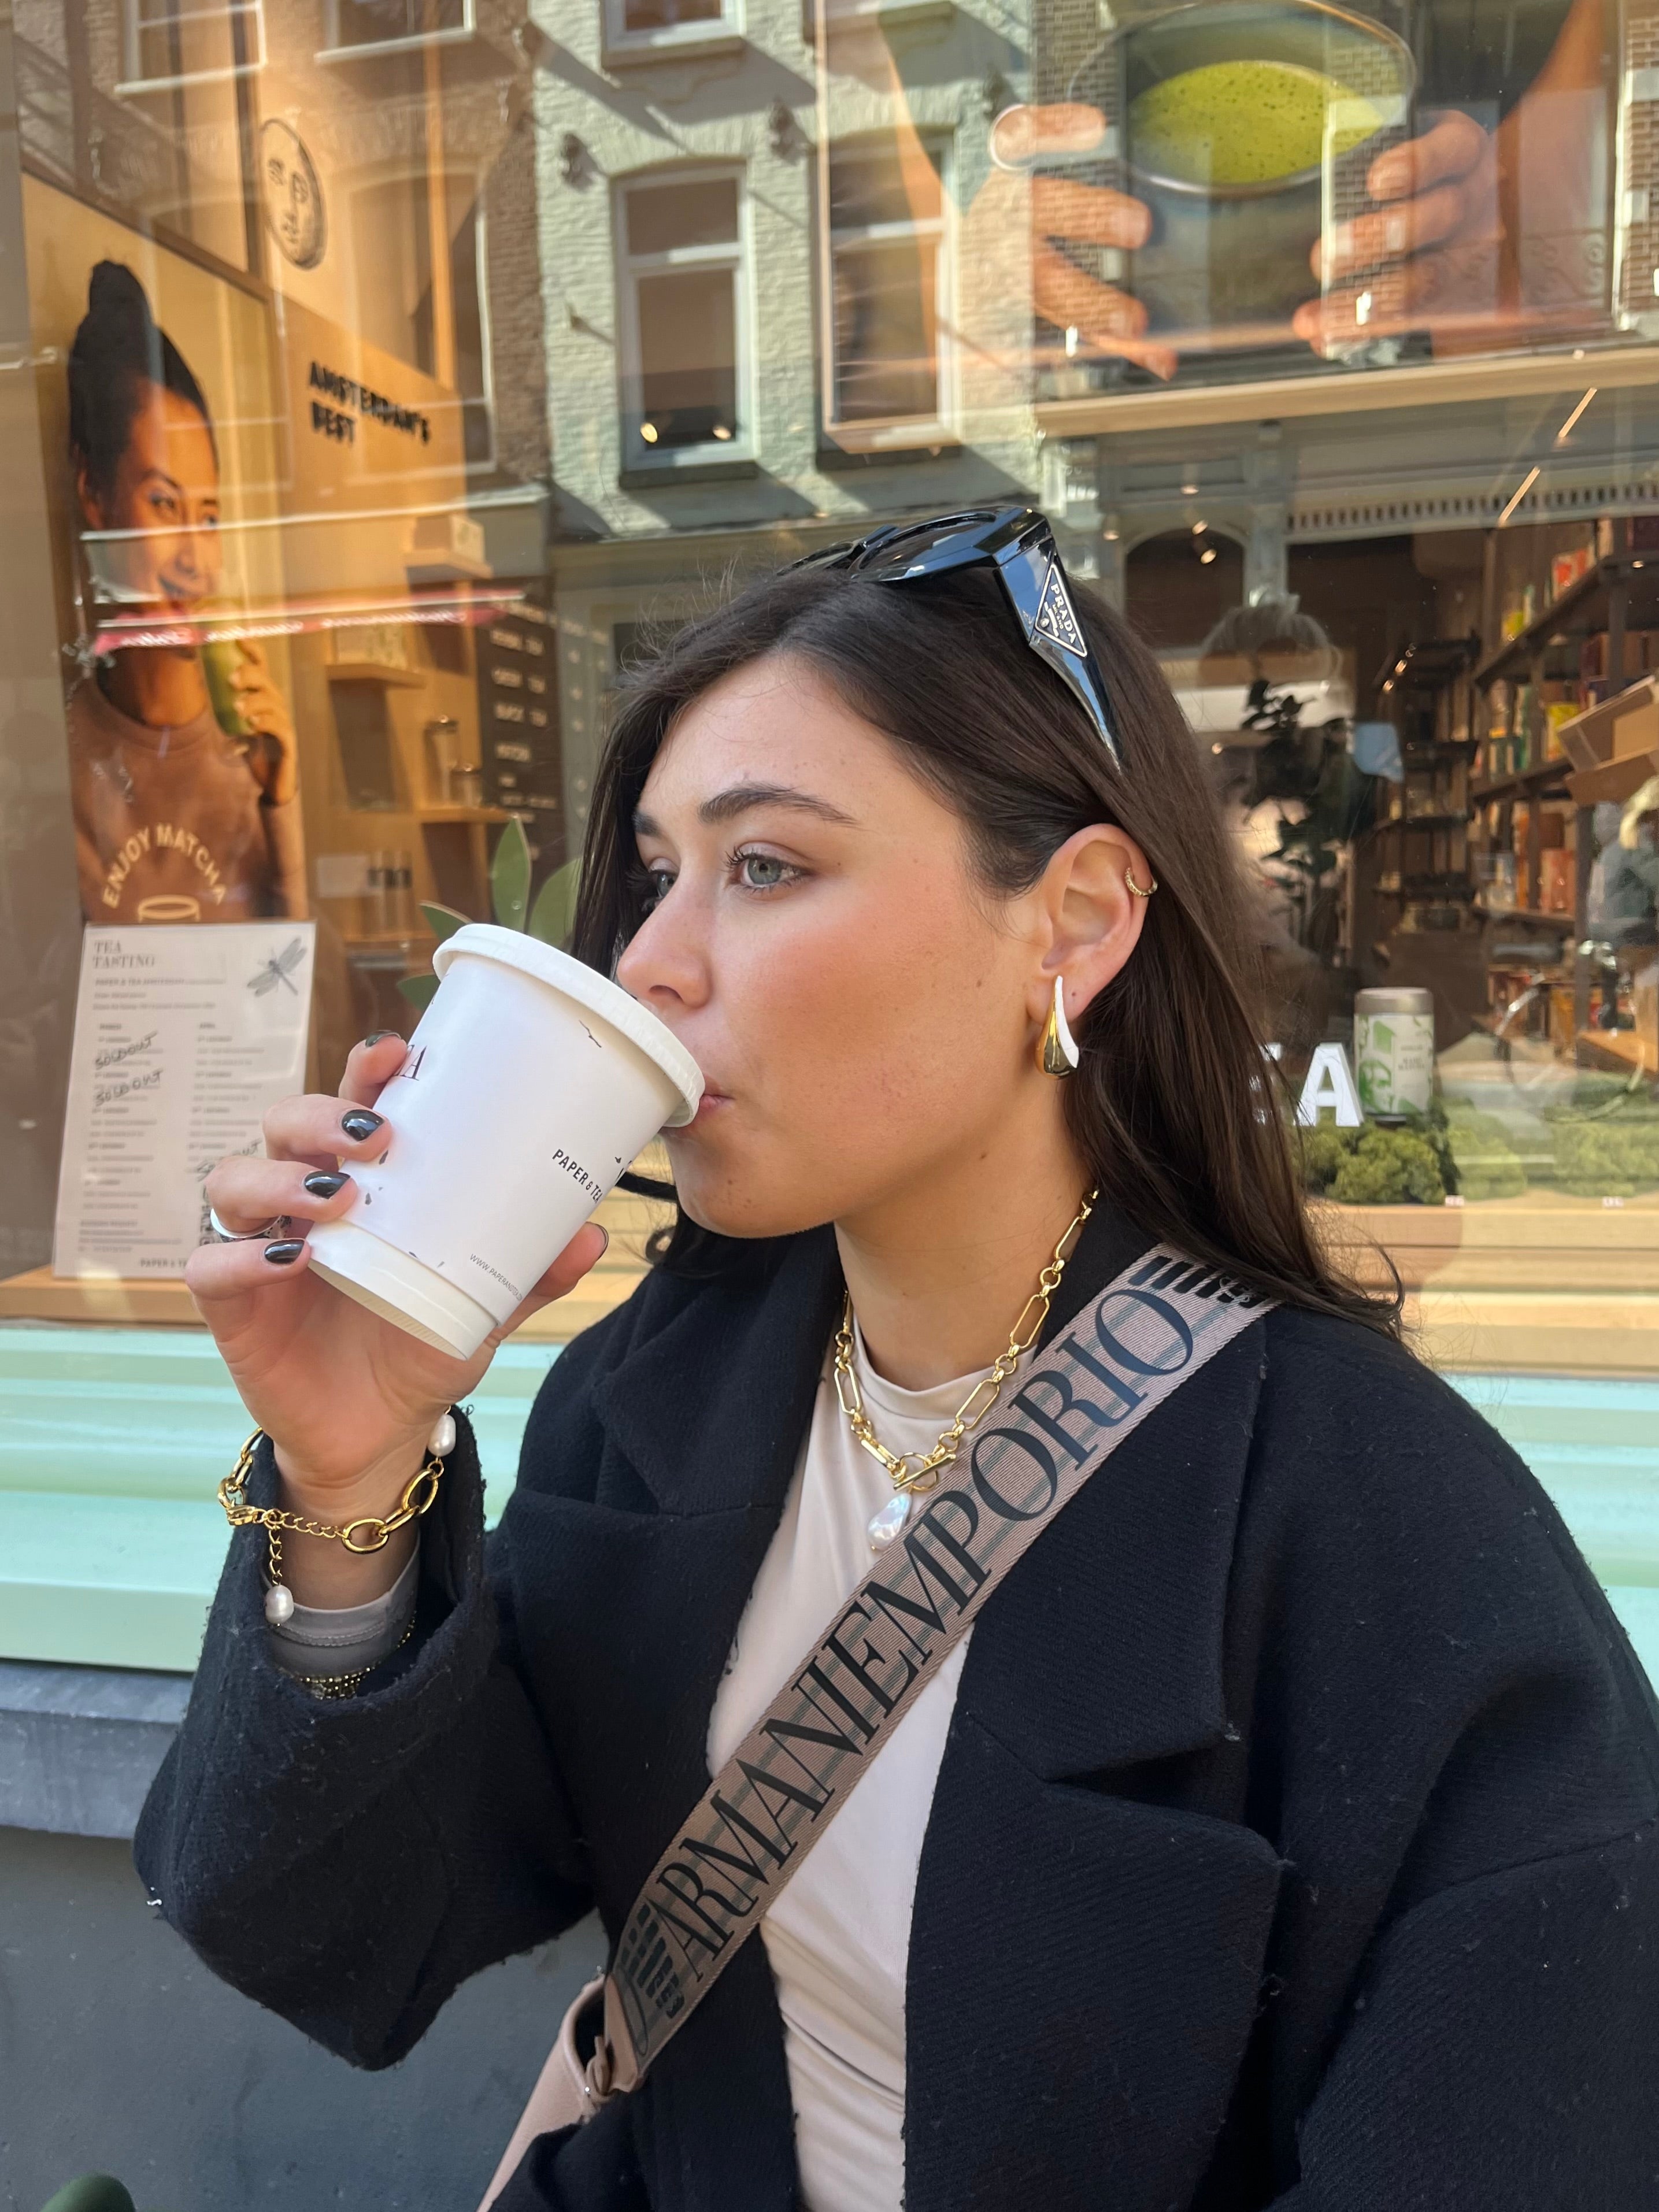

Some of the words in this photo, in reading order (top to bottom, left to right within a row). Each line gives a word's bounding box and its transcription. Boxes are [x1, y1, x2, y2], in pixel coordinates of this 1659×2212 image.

[309, 360, 431, 445] AMSTERDAM'S
[312, 401, 354, 445] BEST
[1050, 583, 1077, 644] PRADA
[1052, 603, 1064, 629] MILANO
[102, 825, 150, 909] ENJOY
[156, 822, 227, 906] MATCHA
[93, 955, 155, 969] TASTING
[94, 939, 122, 954] TEA
[95, 1083, 130, 1107] SOLD
[132, 1068, 164, 1090] OUT
[552, 1148, 588, 1185] PAPER
[586, 1181, 593, 1191] &
[590, 1184, 603, 1203] TEA
[140, 1258, 168, 1268] PAPER
